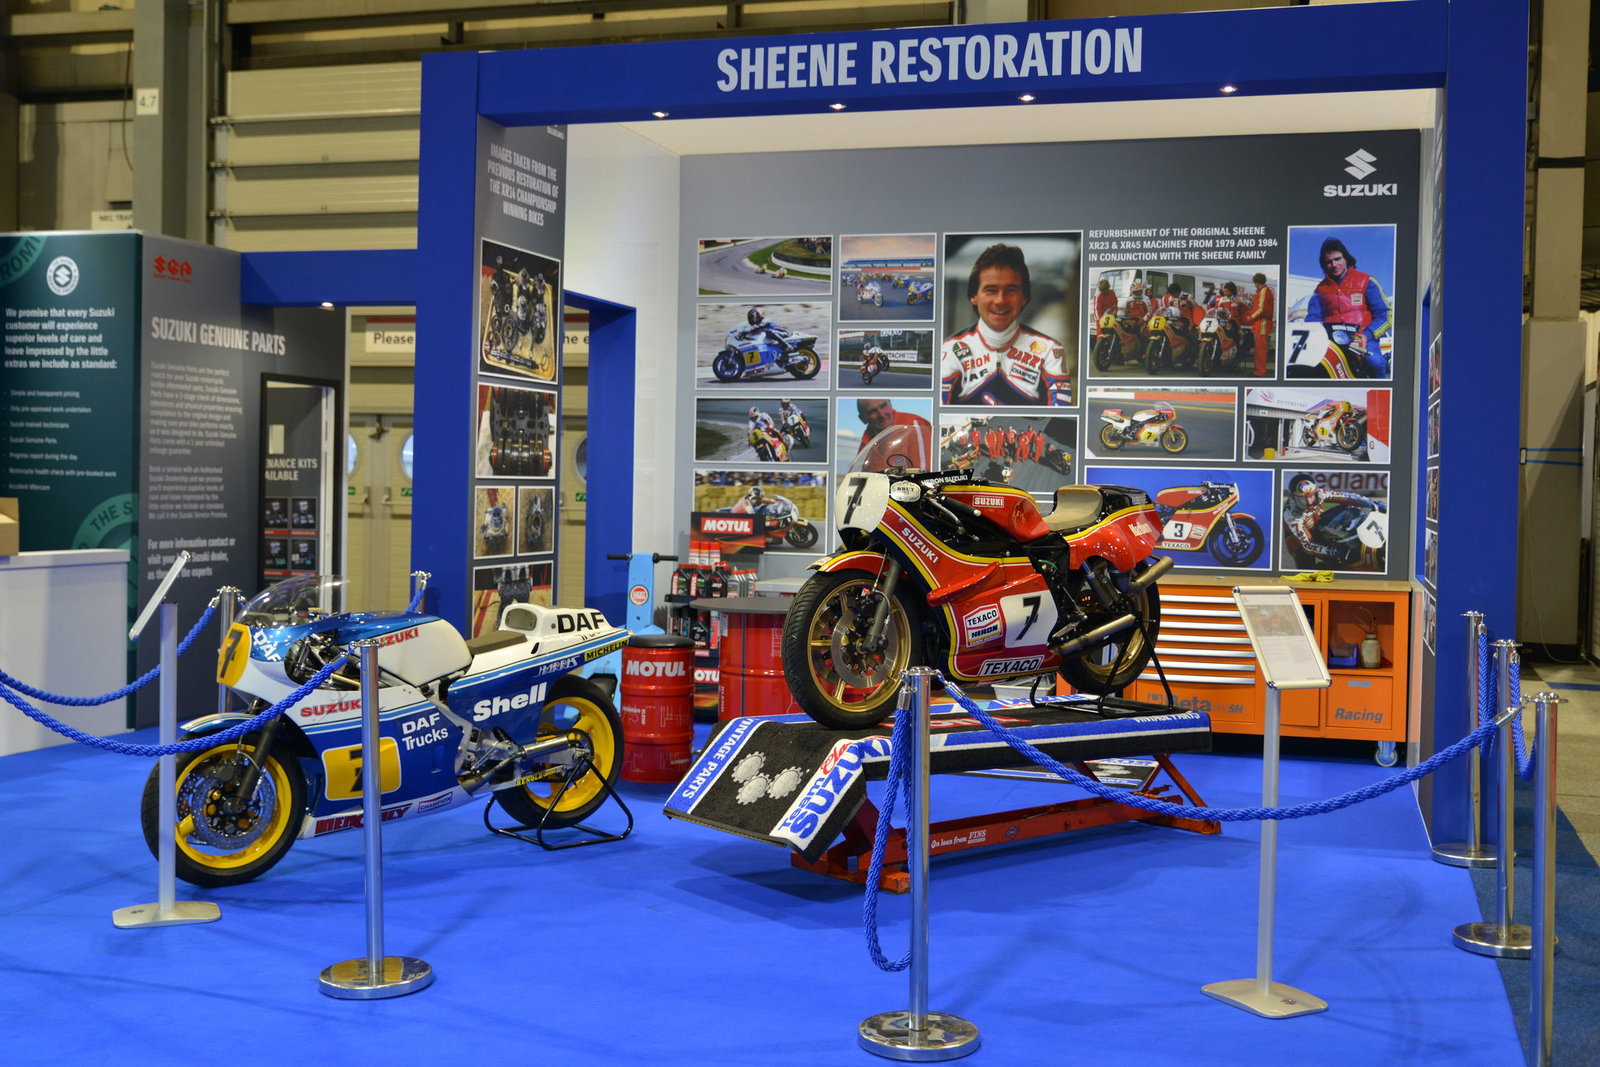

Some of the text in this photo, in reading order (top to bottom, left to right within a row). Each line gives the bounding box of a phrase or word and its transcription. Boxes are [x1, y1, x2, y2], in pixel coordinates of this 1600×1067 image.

[717, 27, 1143, 92] SHEENE RESTORATION
[491, 143, 557, 181] IMAGES TAKEN FROM THE
[488, 160, 558, 198] PREVIOUS RESTORATION OF
[490, 178, 500, 195] THE
[517, 189, 557, 214] CHAMPIONSHIP
[1324, 183, 1398, 197] SUZUKI
[503, 200, 544, 226] WINNING BIKES
[1089, 227, 1266, 238] REFURBISHMENT OF THE ORIGINAL SHEENE
[1089, 238, 1278, 250] XR23 & XR45 MACHINES FROM 1979 AND 1984
[1089, 250, 1266, 262] IN CONJUNCTION WITH THE SHEENE FAMILY
[152, 316, 286, 356] SUZUKI GENUINE PARTS
[374, 332, 414, 344] Please
[1289, 330, 1310, 363] 7
[298, 458, 318, 468] KITS
[1299, 472, 1388, 490] edlan
[843, 477, 867, 524] 7
[975, 497, 1003, 506] SUZUKI
[90, 505, 119, 531] THE
[704, 520, 750, 532] MOTUL
[1174, 523, 1184, 538] 3
[901, 527, 939, 564] SUZUKI
[557, 612, 604, 633] DAF
[967, 610, 997, 625] TEXACO
[1015, 596, 1041, 641] 7
[253, 630, 281, 662] DAF
[377, 627, 419, 648] UZUKI
[219, 629, 243, 679] 7
[586, 640, 628, 659] MICHELIN
[626, 660, 685, 677] MOTUL
[984, 659, 1040, 675] TEXACO
[300, 699, 362, 717] SUZUK
[474, 682, 547, 722] Shell
[1228, 704, 1244, 712] SM
[402, 712, 440, 735] DAF
[1335, 708, 1383, 724] Racing
[402, 728, 448, 751] Trucks
[682, 762, 718, 799] PARTS
[790, 737, 892, 839] SUZUKI
[931, 840, 940, 848] On
[954, 836, 967, 844] from
[969, 830, 986, 839] FINS
